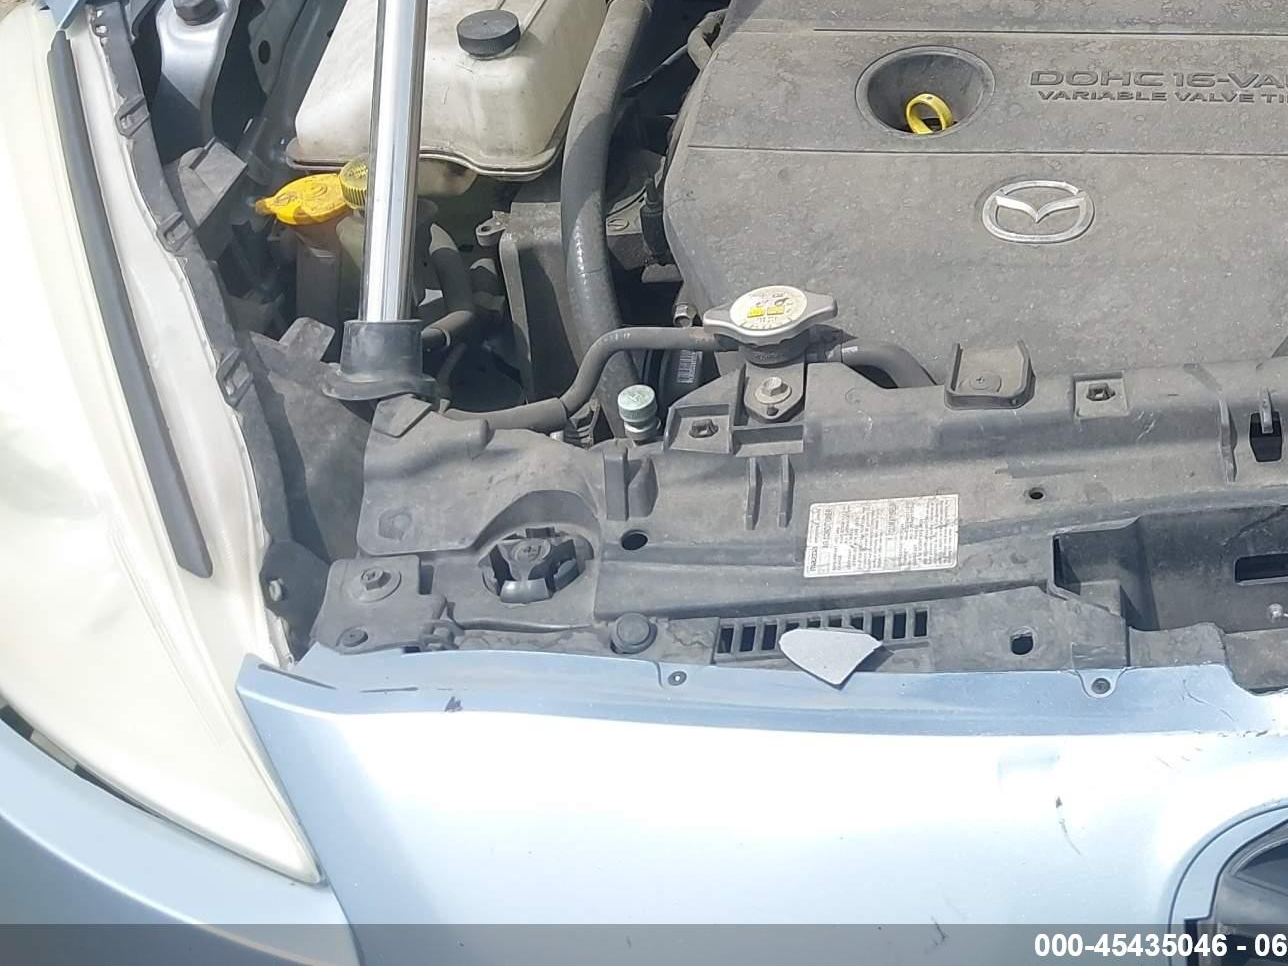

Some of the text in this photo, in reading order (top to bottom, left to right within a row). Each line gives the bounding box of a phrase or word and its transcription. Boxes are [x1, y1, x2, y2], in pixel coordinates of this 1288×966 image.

[1030, 70, 1165, 87] DOHC
[1037, 90, 1167, 102] VARIABLE
[1174, 91, 1255, 103] VALVE
